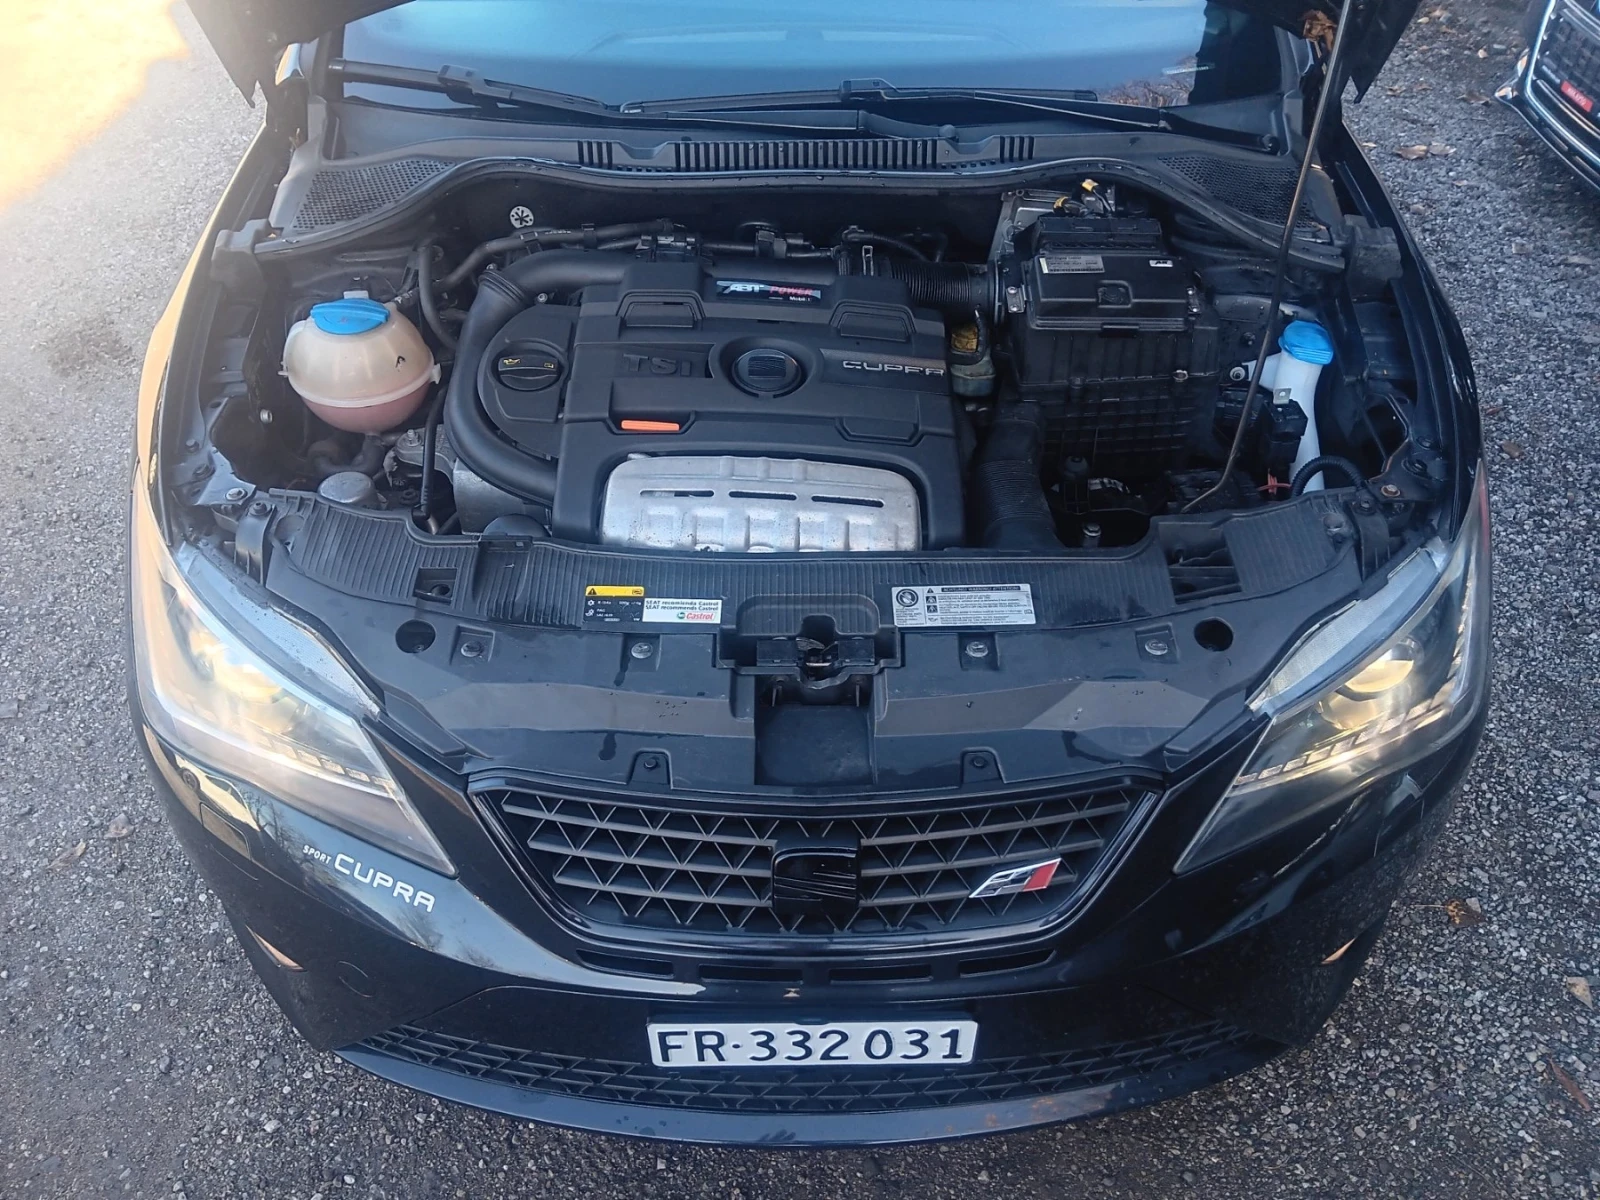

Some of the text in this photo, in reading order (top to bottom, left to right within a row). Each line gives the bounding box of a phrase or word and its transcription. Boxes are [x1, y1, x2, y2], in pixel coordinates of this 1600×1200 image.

[723, 283, 813, 296] ABT POWER
[622, 353, 692, 377] TSI
[842, 360, 945, 377] CUPRA
[686, 612, 714, 620] Castrol
[302, 844, 436, 913] SPORT CUPRA
